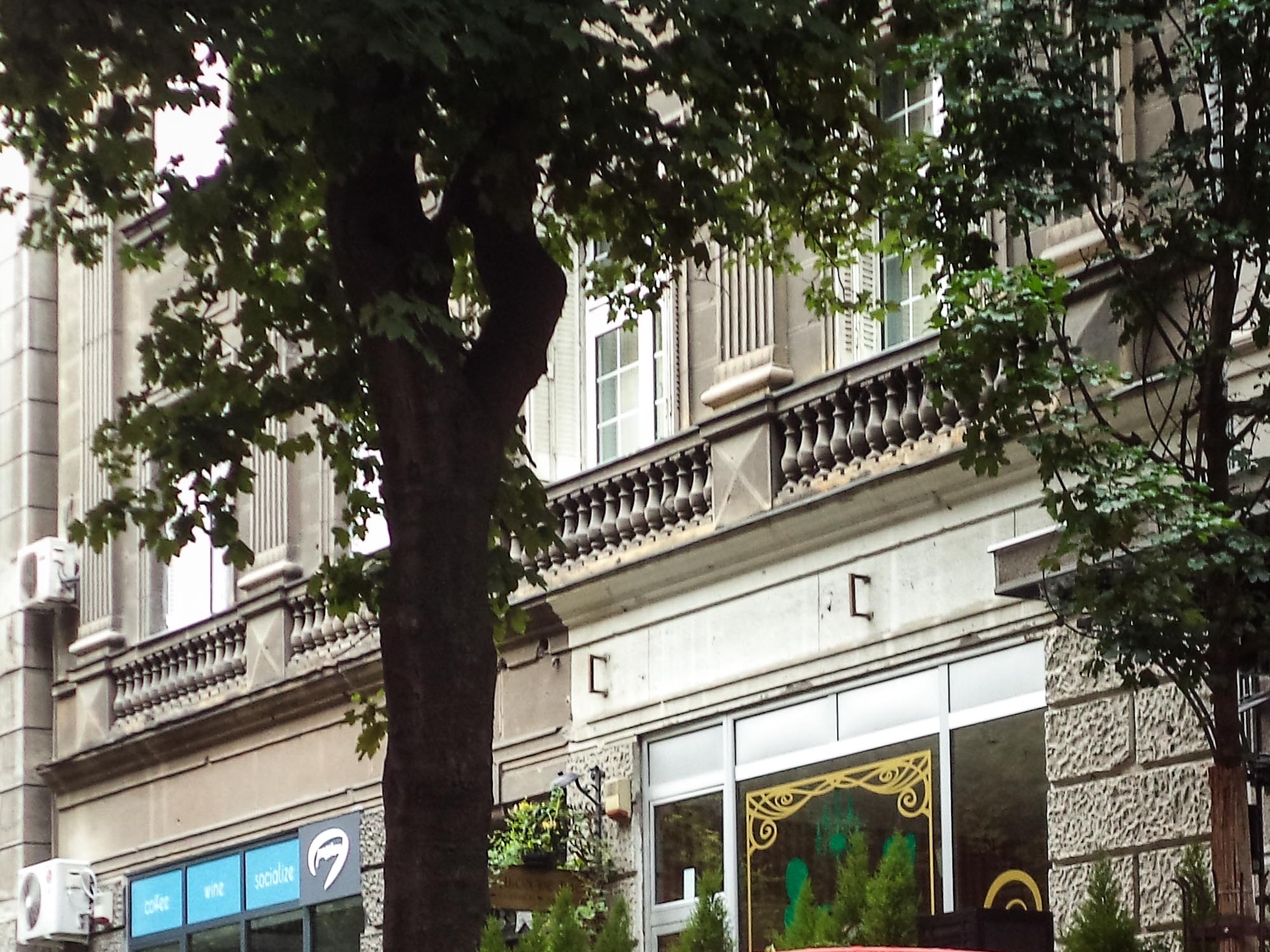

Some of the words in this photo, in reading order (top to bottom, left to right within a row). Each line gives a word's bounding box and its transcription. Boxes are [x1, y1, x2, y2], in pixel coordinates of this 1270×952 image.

[254, 862, 294, 889] socialize
[204, 881, 225, 899] wine
[144, 895, 170, 915] coffee
